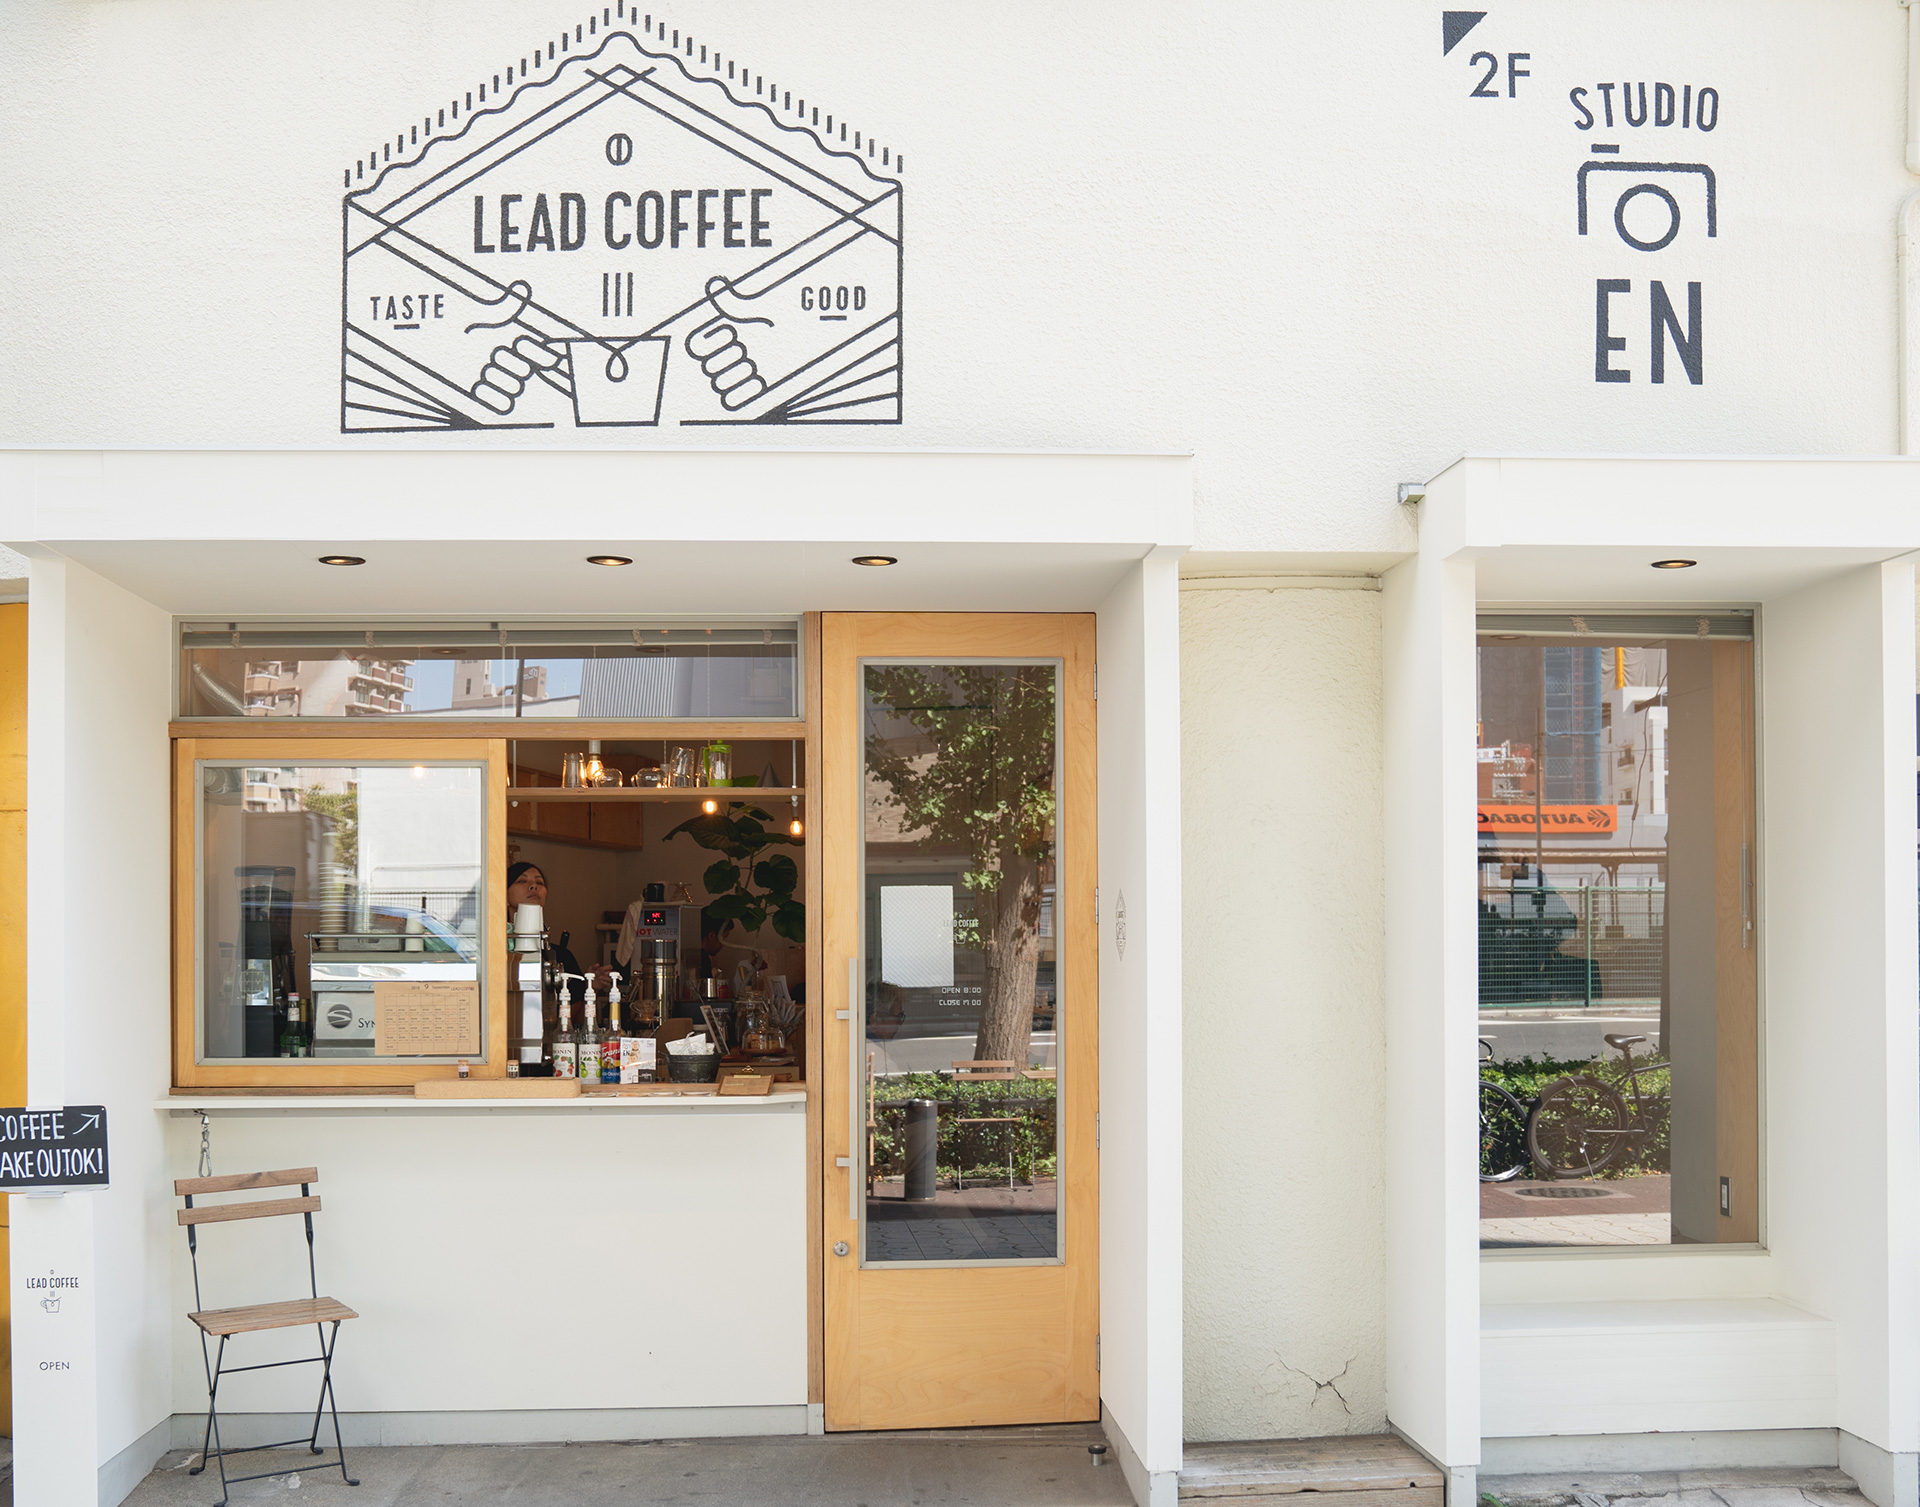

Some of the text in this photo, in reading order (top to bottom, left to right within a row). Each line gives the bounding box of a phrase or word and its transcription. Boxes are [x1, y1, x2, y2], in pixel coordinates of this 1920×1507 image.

[1469, 51, 1531, 98] 2F
[1569, 82, 1719, 132] STUDIO
[473, 188, 773, 253] LEAD COFFEE
[370, 294, 445, 321] TASTE
[801, 286, 866, 311] GOOD
[1595, 278, 1703, 386] EN
[652, 928, 679, 936] WATER
[944, 919, 979, 928] LED COFFEE
[0, 1112, 66, 1143] COFFEE
[26, 1277, 80, 1289] LEAD COFFEE
[39, 1361, 70, 1371] OPEN
